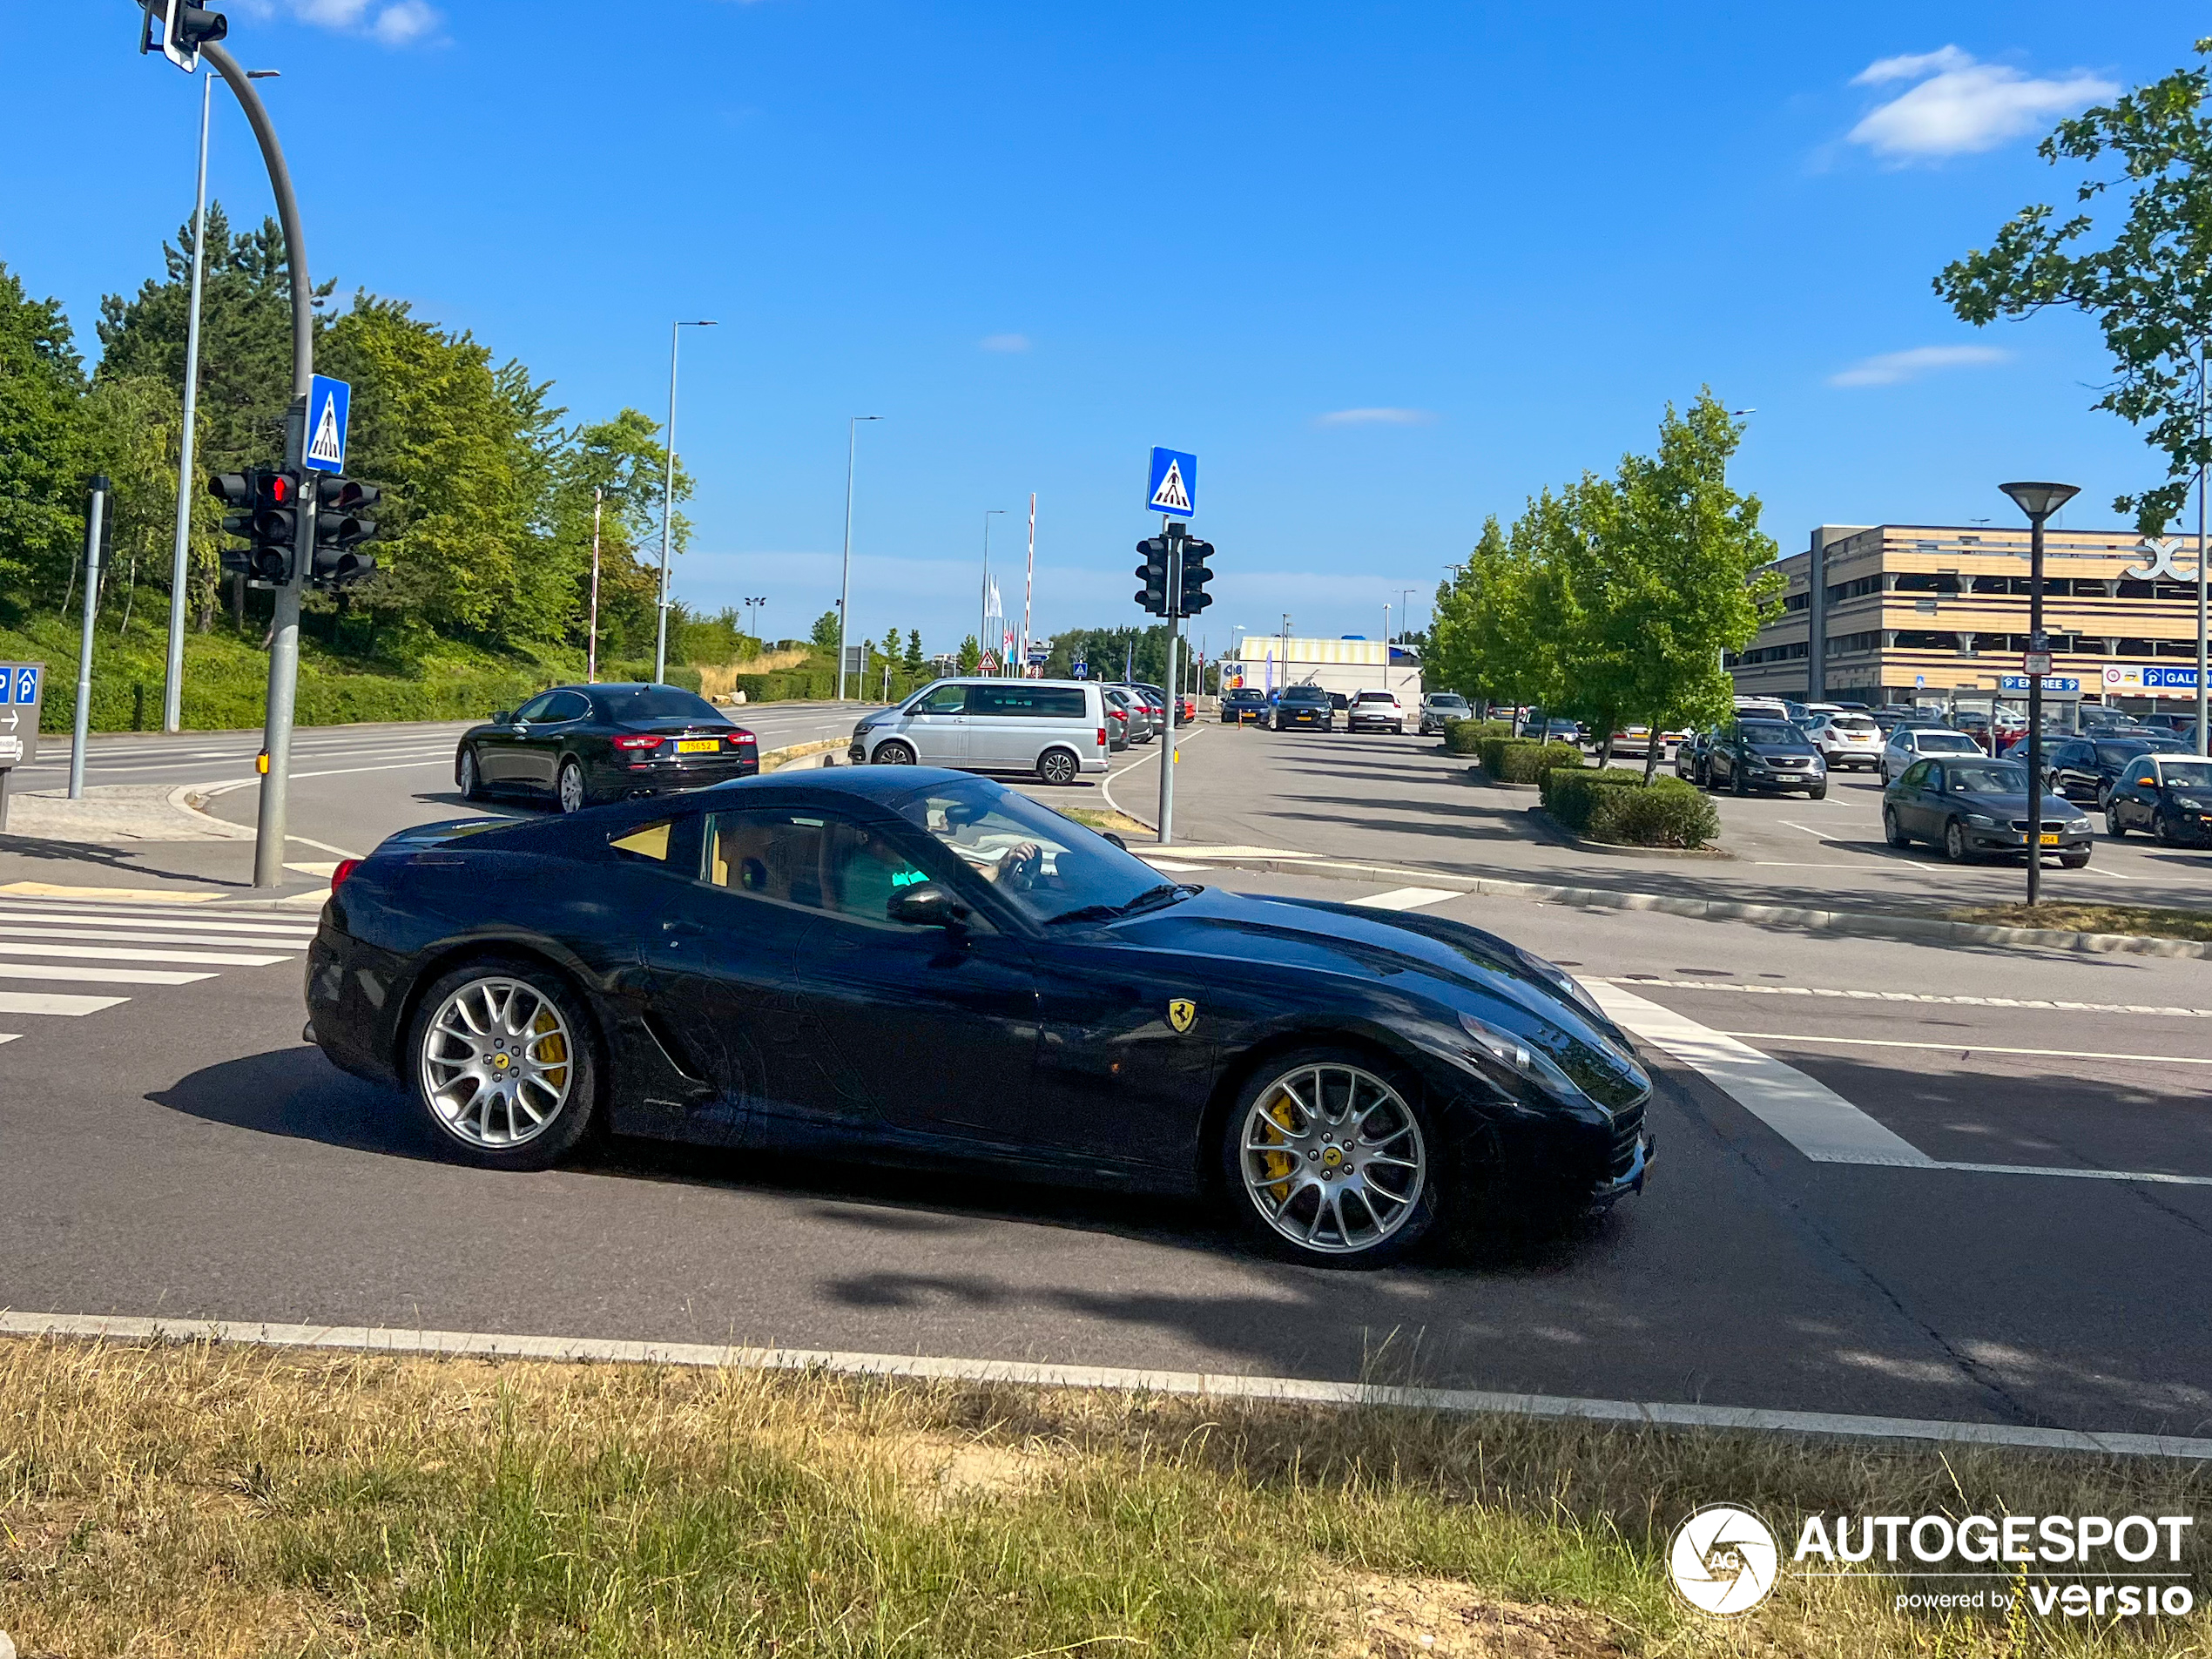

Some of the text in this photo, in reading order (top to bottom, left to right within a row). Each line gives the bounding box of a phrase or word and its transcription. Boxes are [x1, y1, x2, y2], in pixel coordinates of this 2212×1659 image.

[2018, 678, 2063, 689] ENREE
[2166, 672, 2212, 685] GALE
[685, 742, 711, 751] 75652
